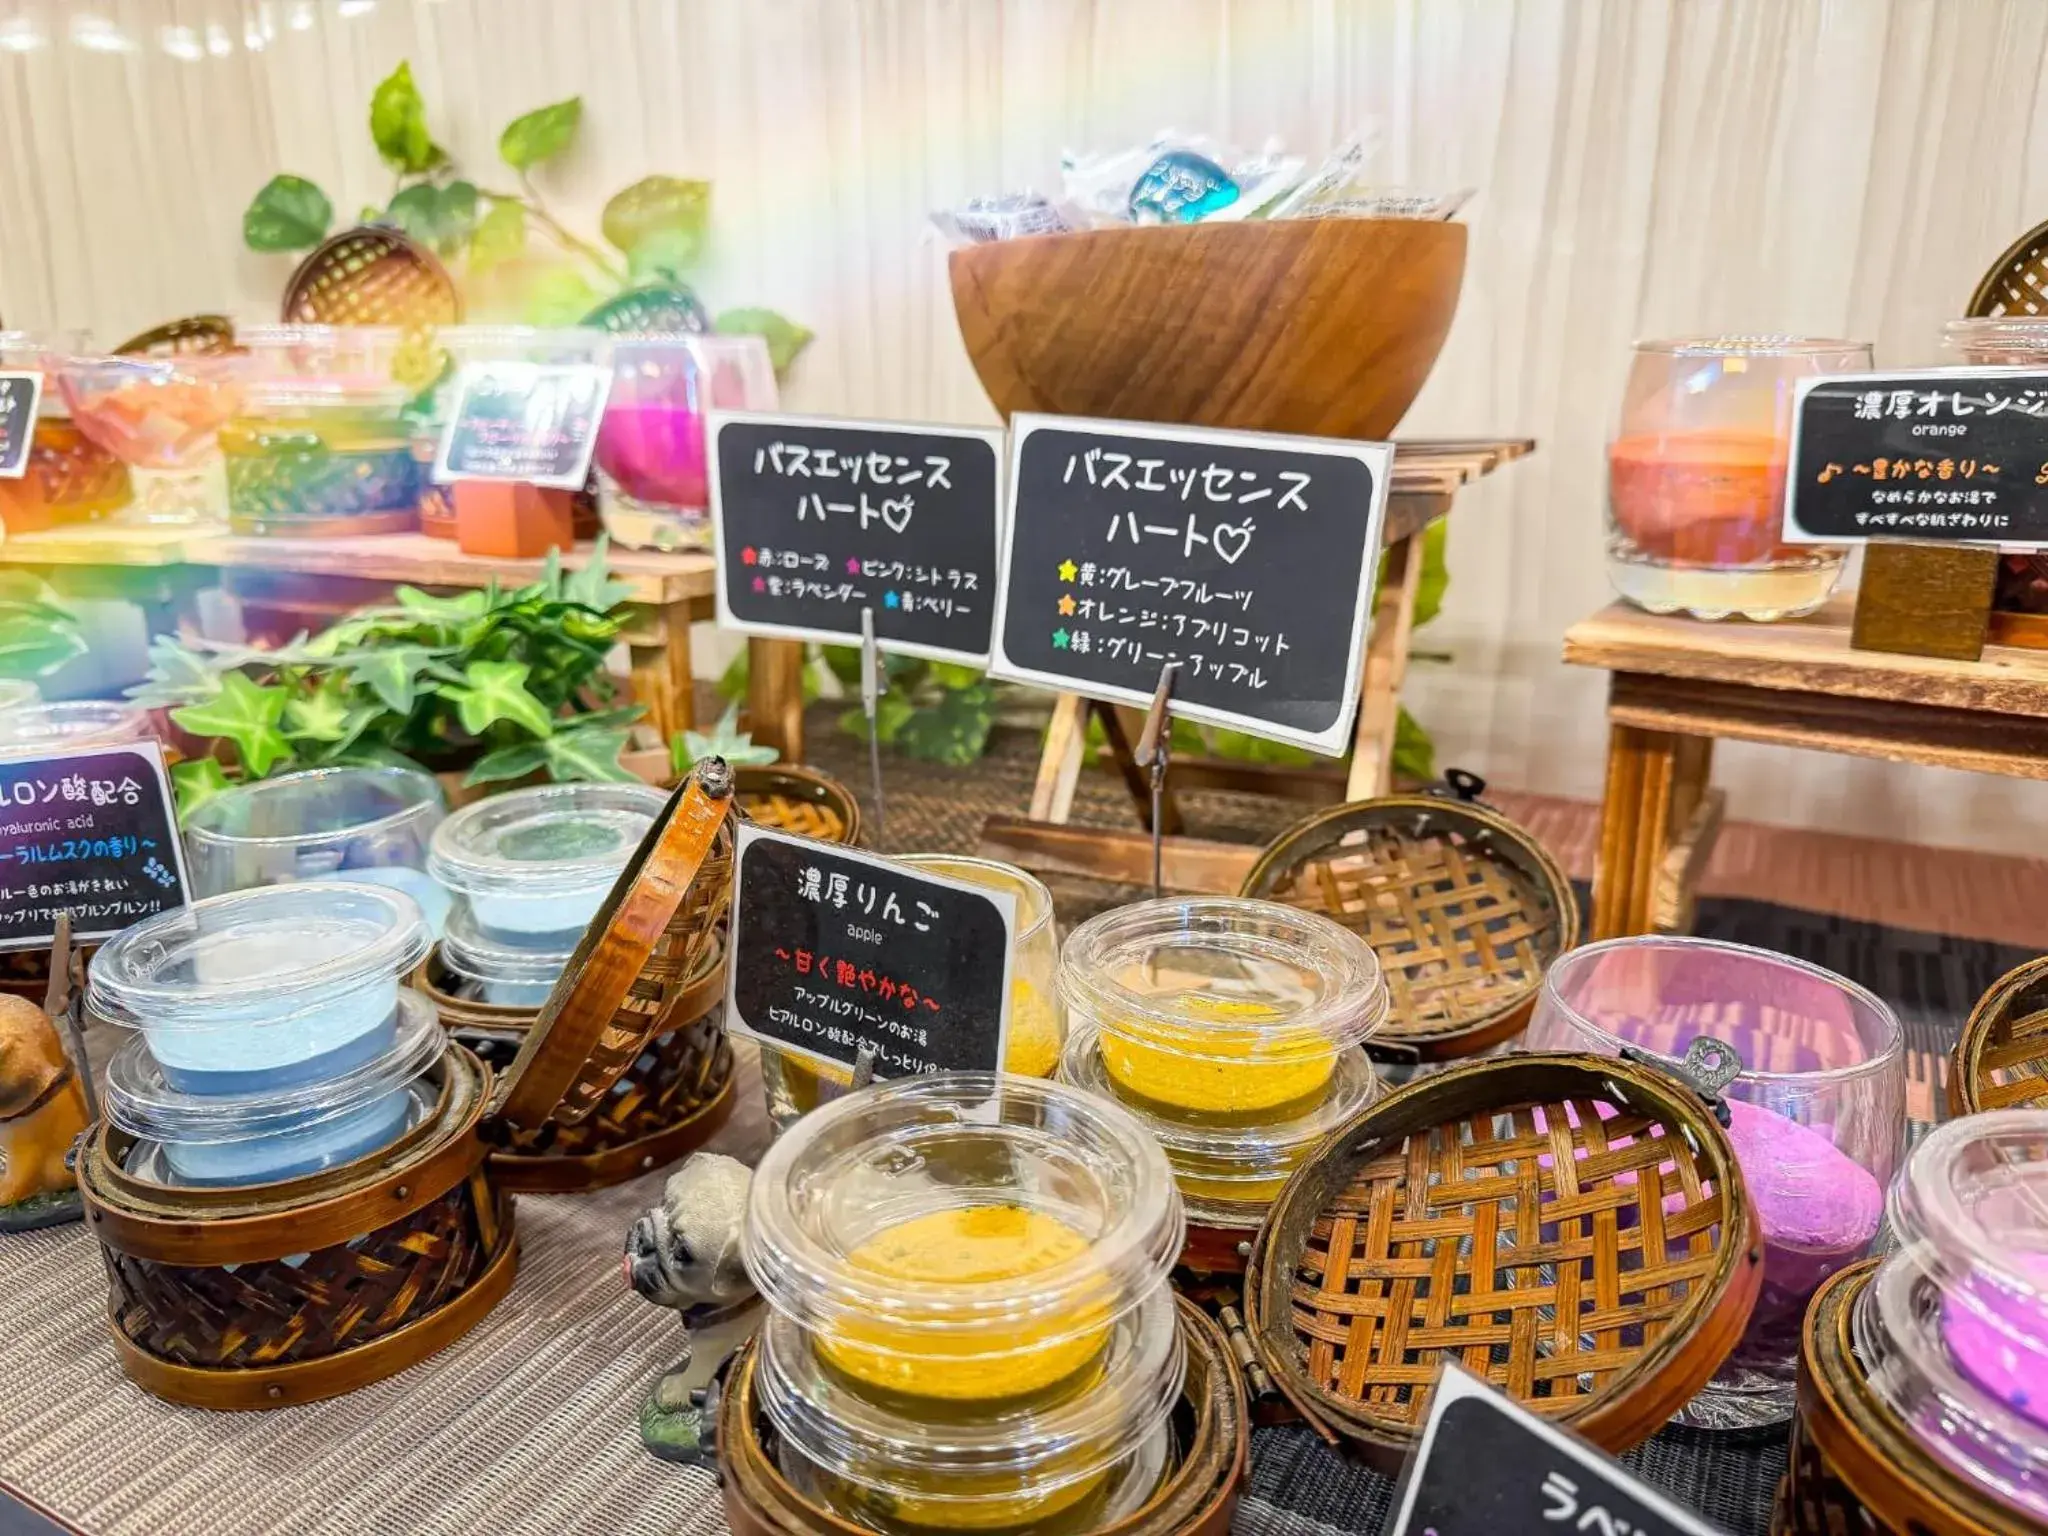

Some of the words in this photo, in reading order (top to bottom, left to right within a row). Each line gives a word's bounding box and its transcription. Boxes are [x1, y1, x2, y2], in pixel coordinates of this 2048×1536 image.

[1911, 424, 1968, 437] orange
[753, 441, 953, 490] バスエッセンス
[1063, 447, 1314, 512] バスエッセンス
[1871, 489, 1998, 505] なめらかなお湯で
[1854, 511, 2010, 528] すべすべな肌ざわりに
[66, 813, 96, 831] acid
[797, 865, 940, 932] 濃厚りんご
[846, 922, 884, 945] apple
[793, 986, 928, 1048] アップルグリーンのお湯
[1540, 1471, 1647, 1536] ラベ
